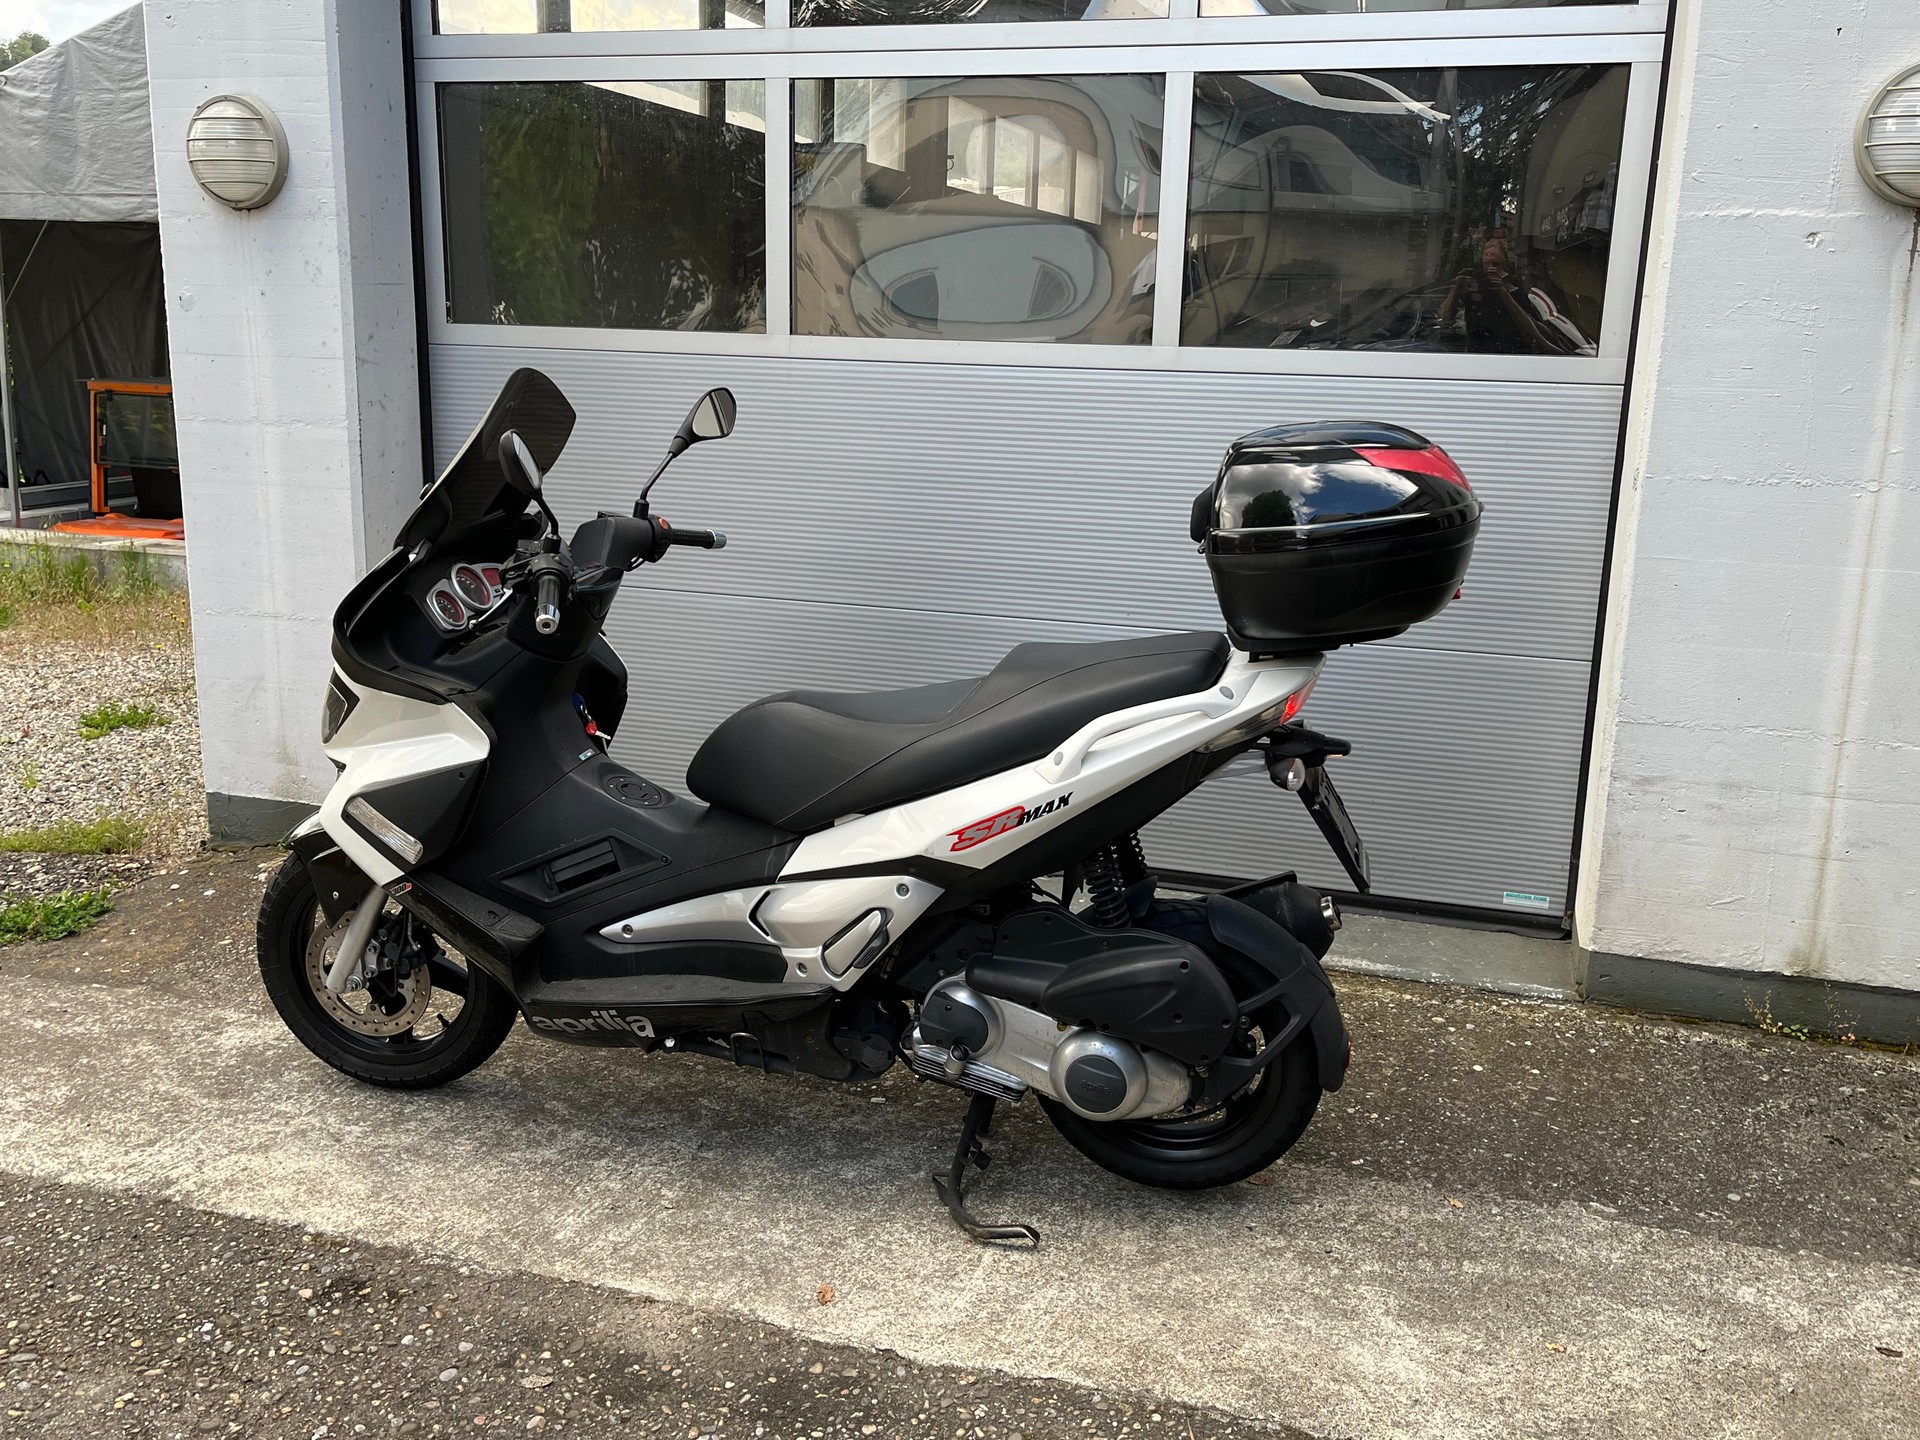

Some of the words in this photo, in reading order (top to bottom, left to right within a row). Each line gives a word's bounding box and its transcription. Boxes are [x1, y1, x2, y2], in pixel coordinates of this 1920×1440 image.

[948, 806, 1024, 852] SR
[1017, 791, 1074, 827] MAX
[531, 1009, 656, 1038] aprilia
